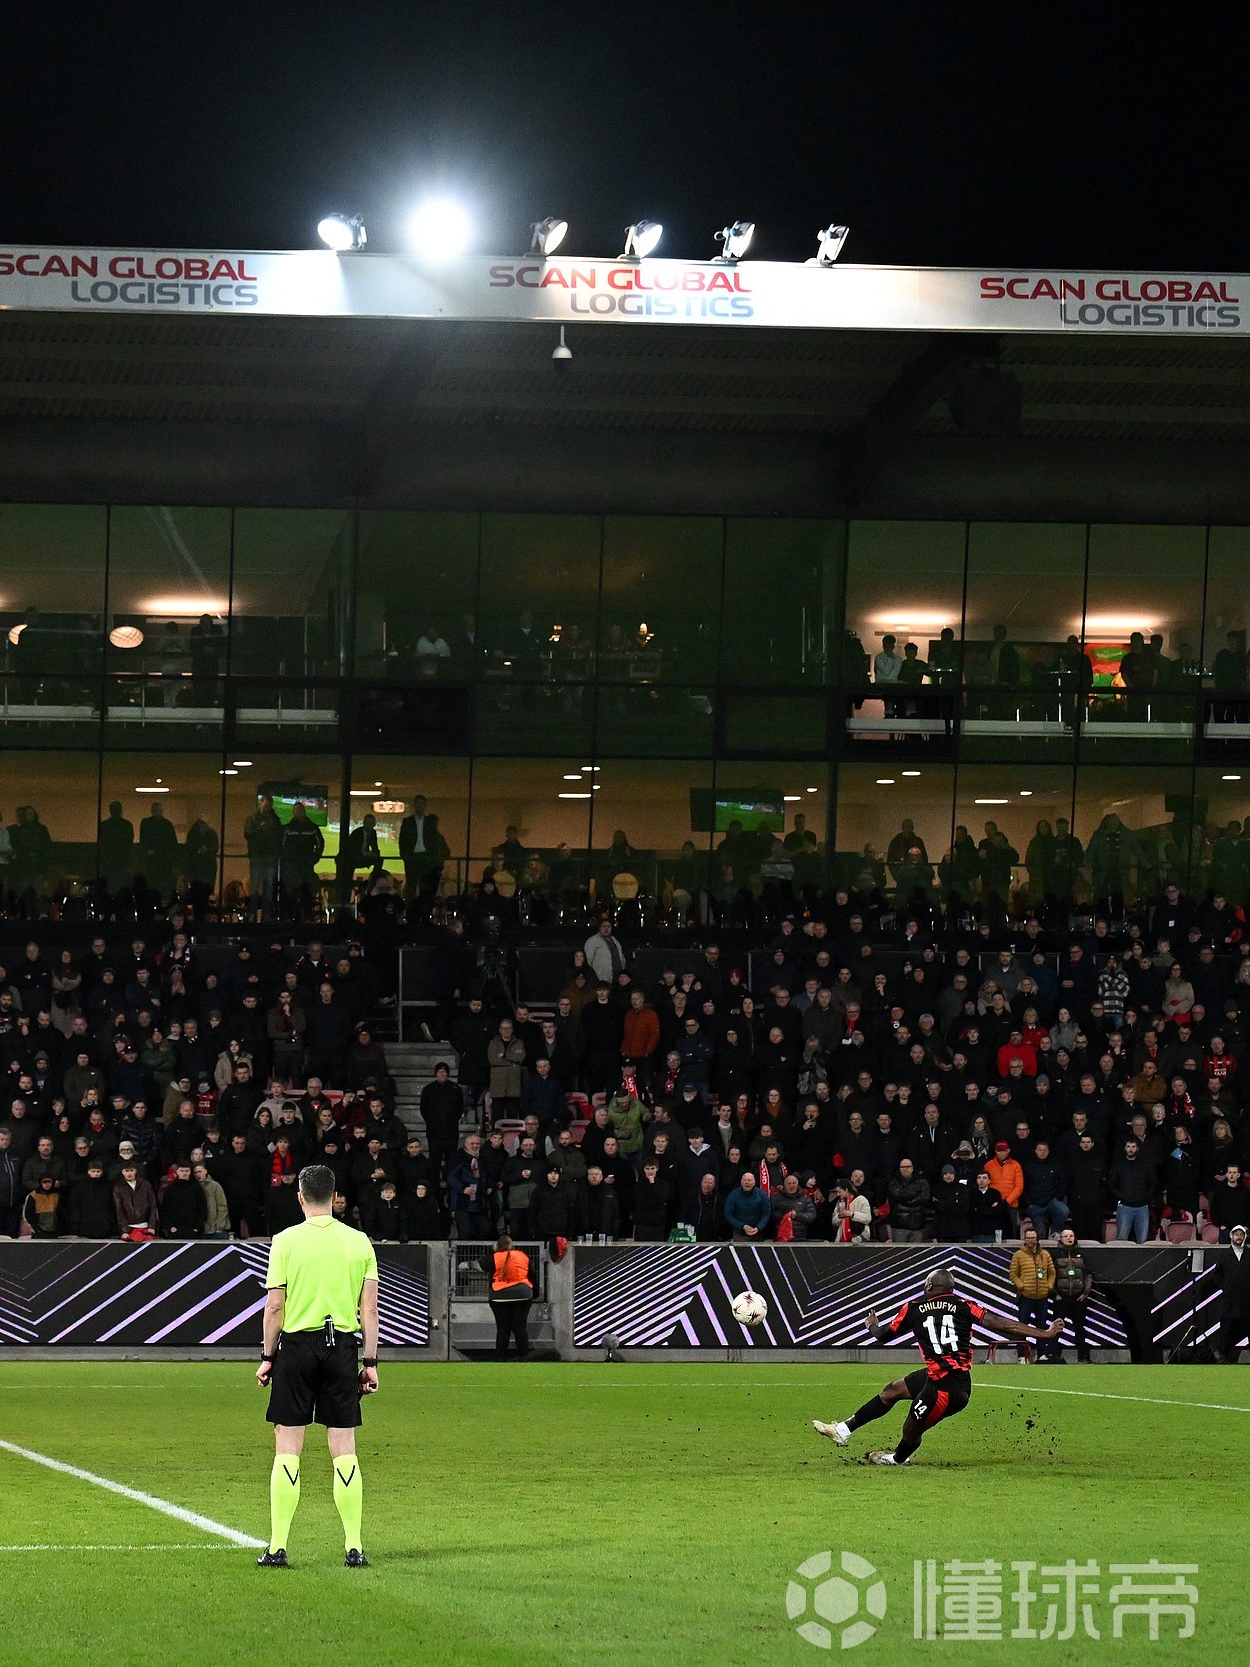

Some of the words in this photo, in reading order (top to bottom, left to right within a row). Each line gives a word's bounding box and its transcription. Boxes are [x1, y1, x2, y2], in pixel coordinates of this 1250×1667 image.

[108, 255, 258, 282] GLOBAL
[488, 265, 597, 290] SCAN
[607, 268, 753, 293] GLOBAL
[70, 280, 259, 306] LOGISTICS
[979, 276, 1085, 301] SCAN
[1095, 279, 1240, 303] GLOBAL
[569, 291, 754, 318] LOGISTICS
[1060, 302, 1241, 328] LOGISTICS
[918, 1300, 958, 1314] CHILUFYA
[922, 1314, 959, 1355] 14
[913, 1399, 928, 1415] 14
